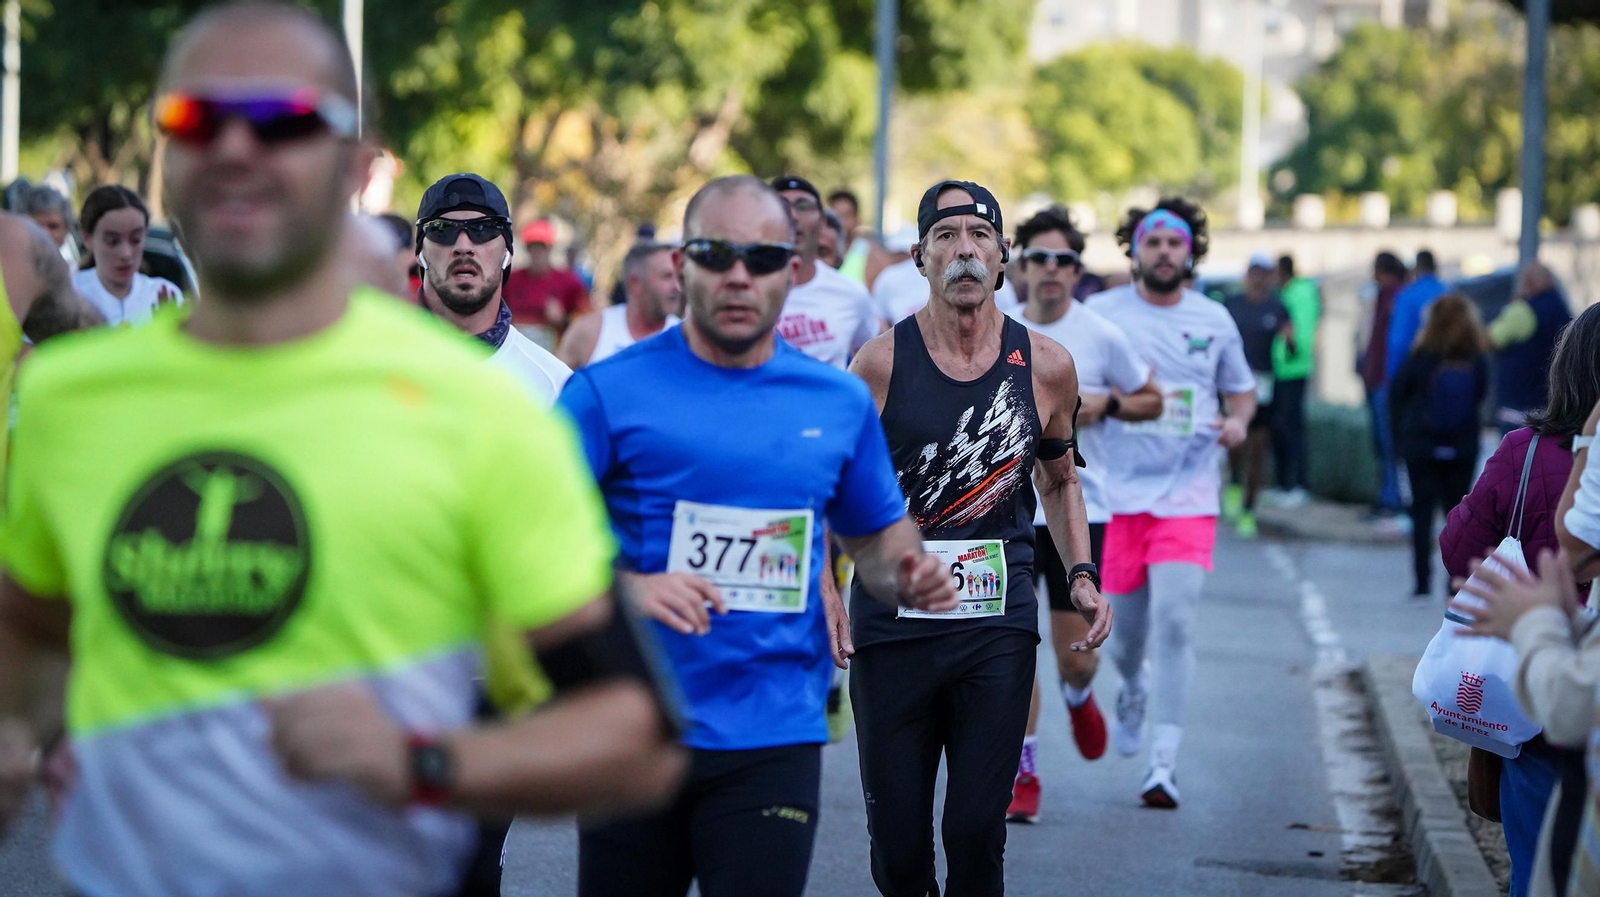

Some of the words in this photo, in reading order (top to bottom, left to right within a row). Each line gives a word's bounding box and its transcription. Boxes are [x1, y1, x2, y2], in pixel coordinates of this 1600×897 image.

[1006, 357, 1026, 367] adidas
[688, 533, 757, 573] 377
[1430, 701, 1508, 731] Ayuntamiento
[1444, 718, 1458, 727] de
[1461, 722, 1490, 737] Jerez
